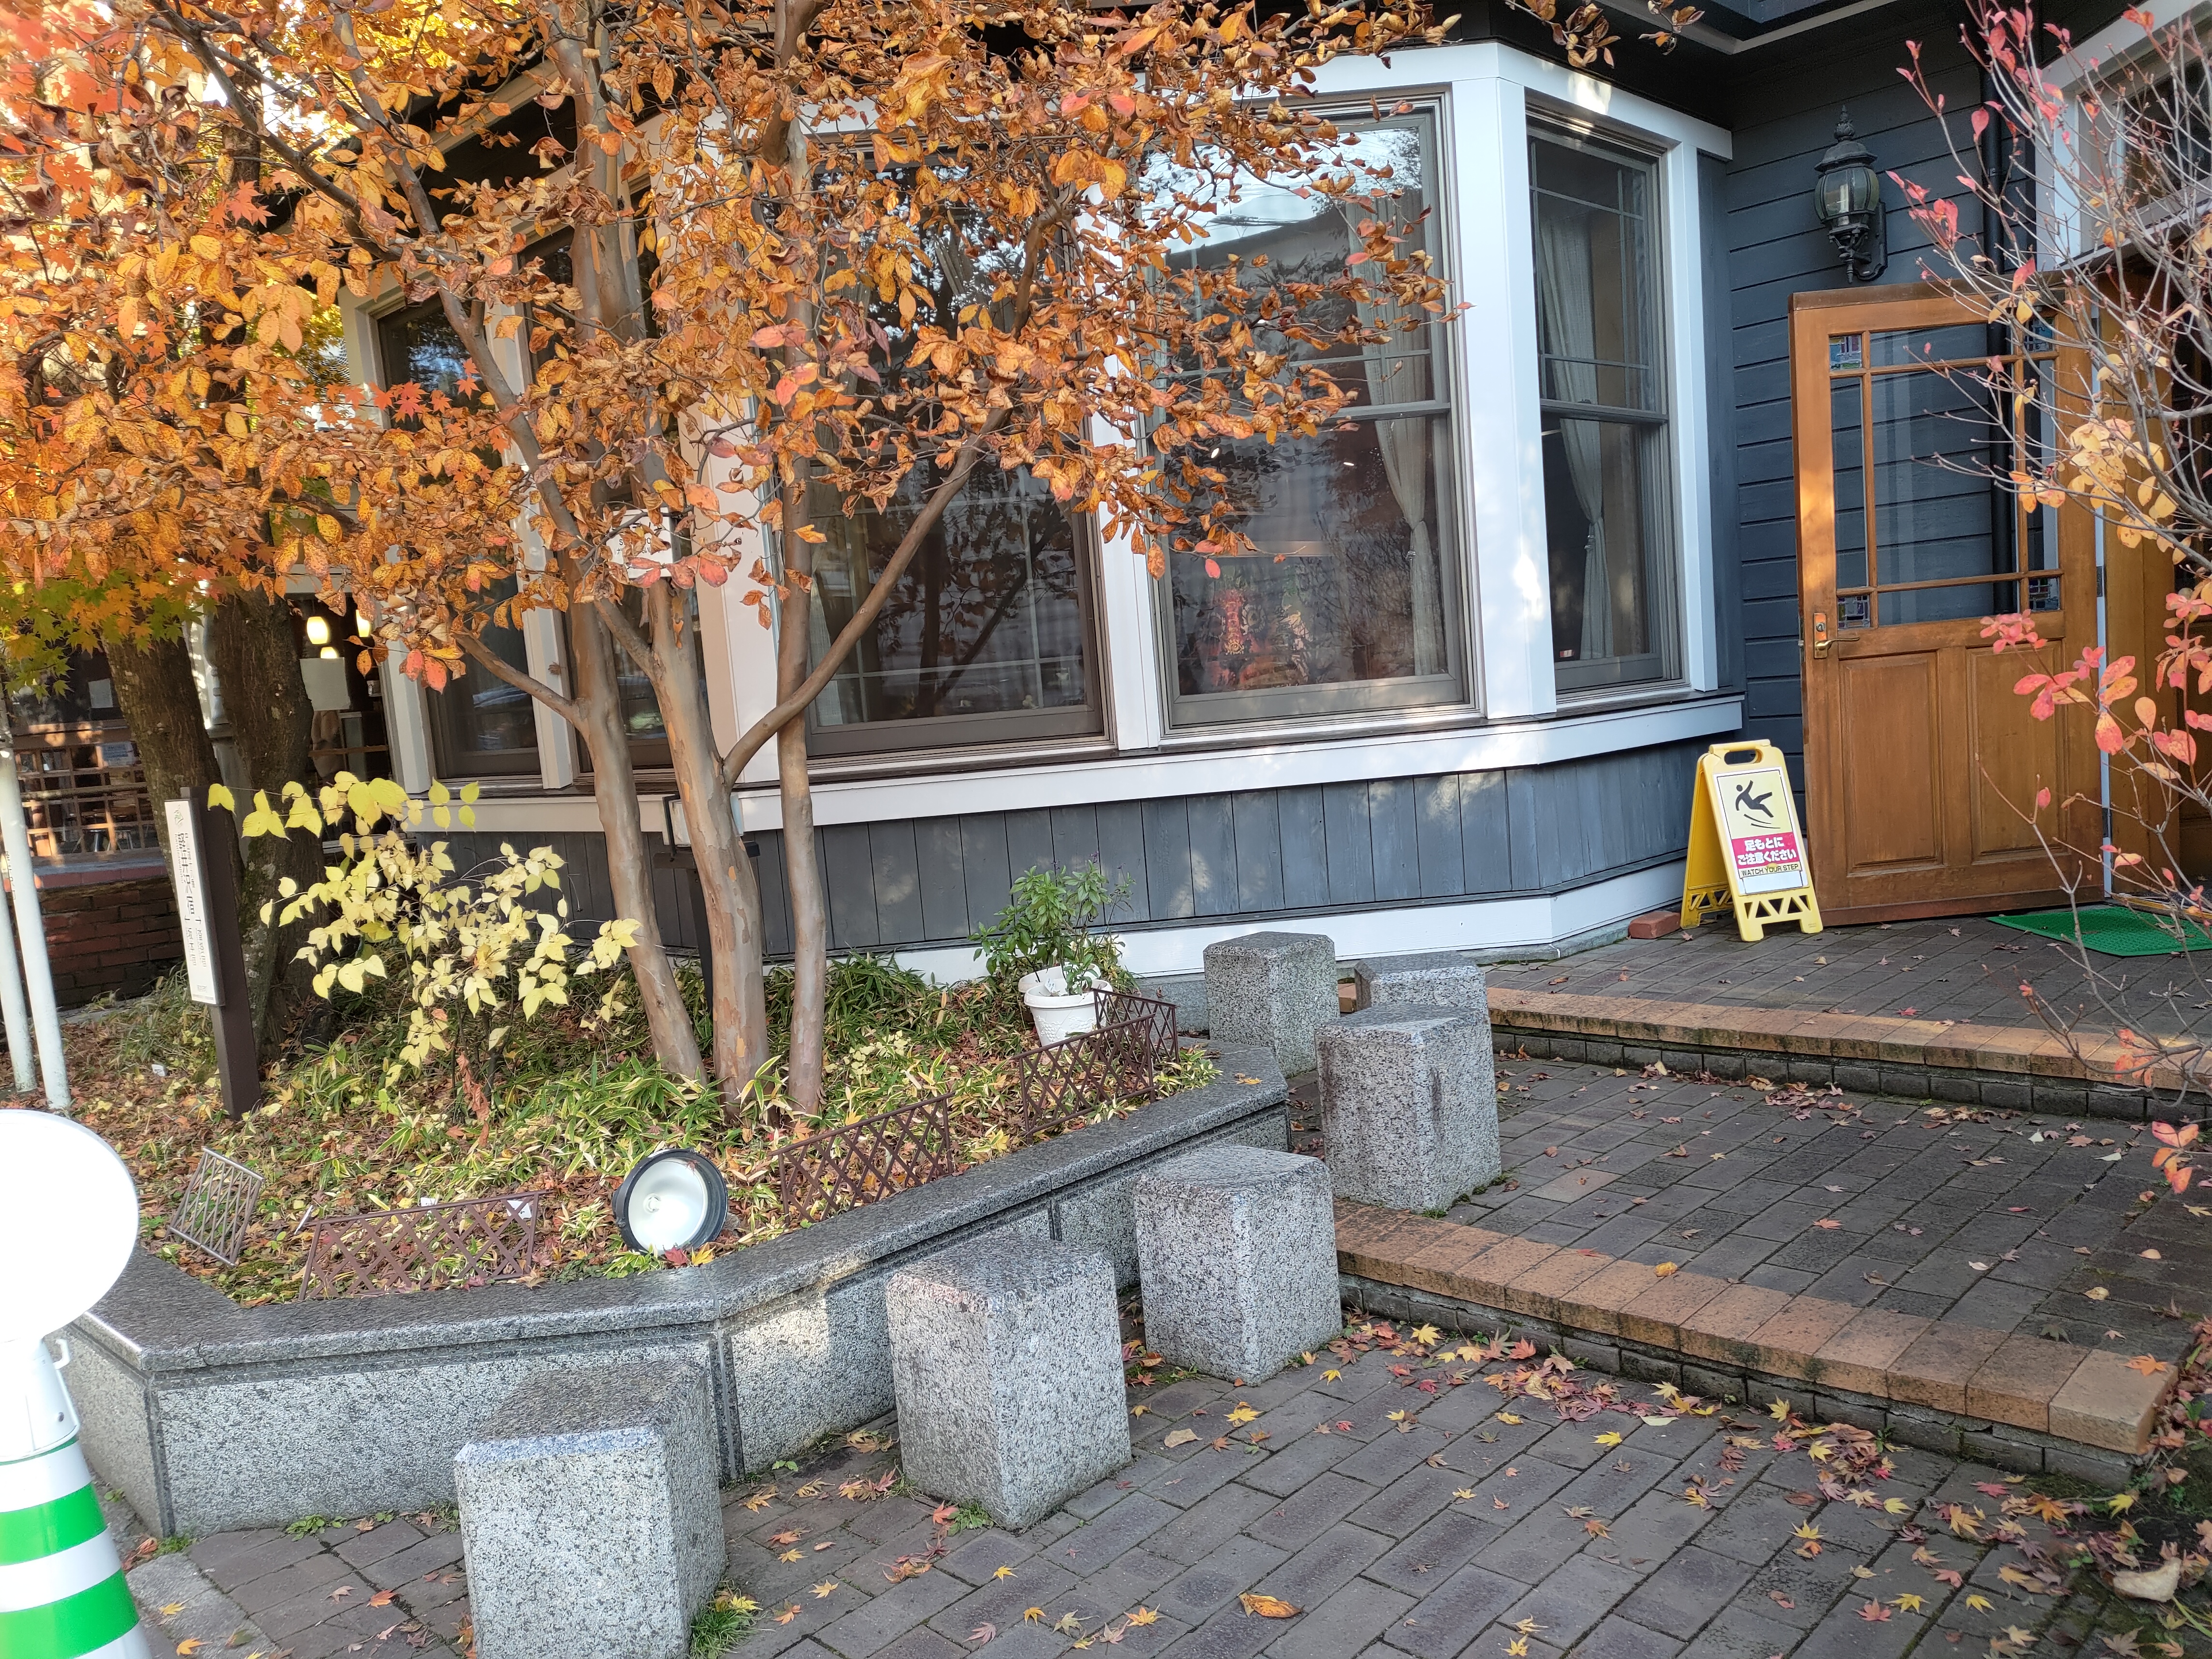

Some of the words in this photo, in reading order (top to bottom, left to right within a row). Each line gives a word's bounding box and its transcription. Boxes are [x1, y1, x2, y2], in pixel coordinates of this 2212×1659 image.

[1744, 837, 1785, 852] 足もとに
[1737, 849, 1797, 865] ご注意ください
[1741, 868, 1763, 876] WATCH
